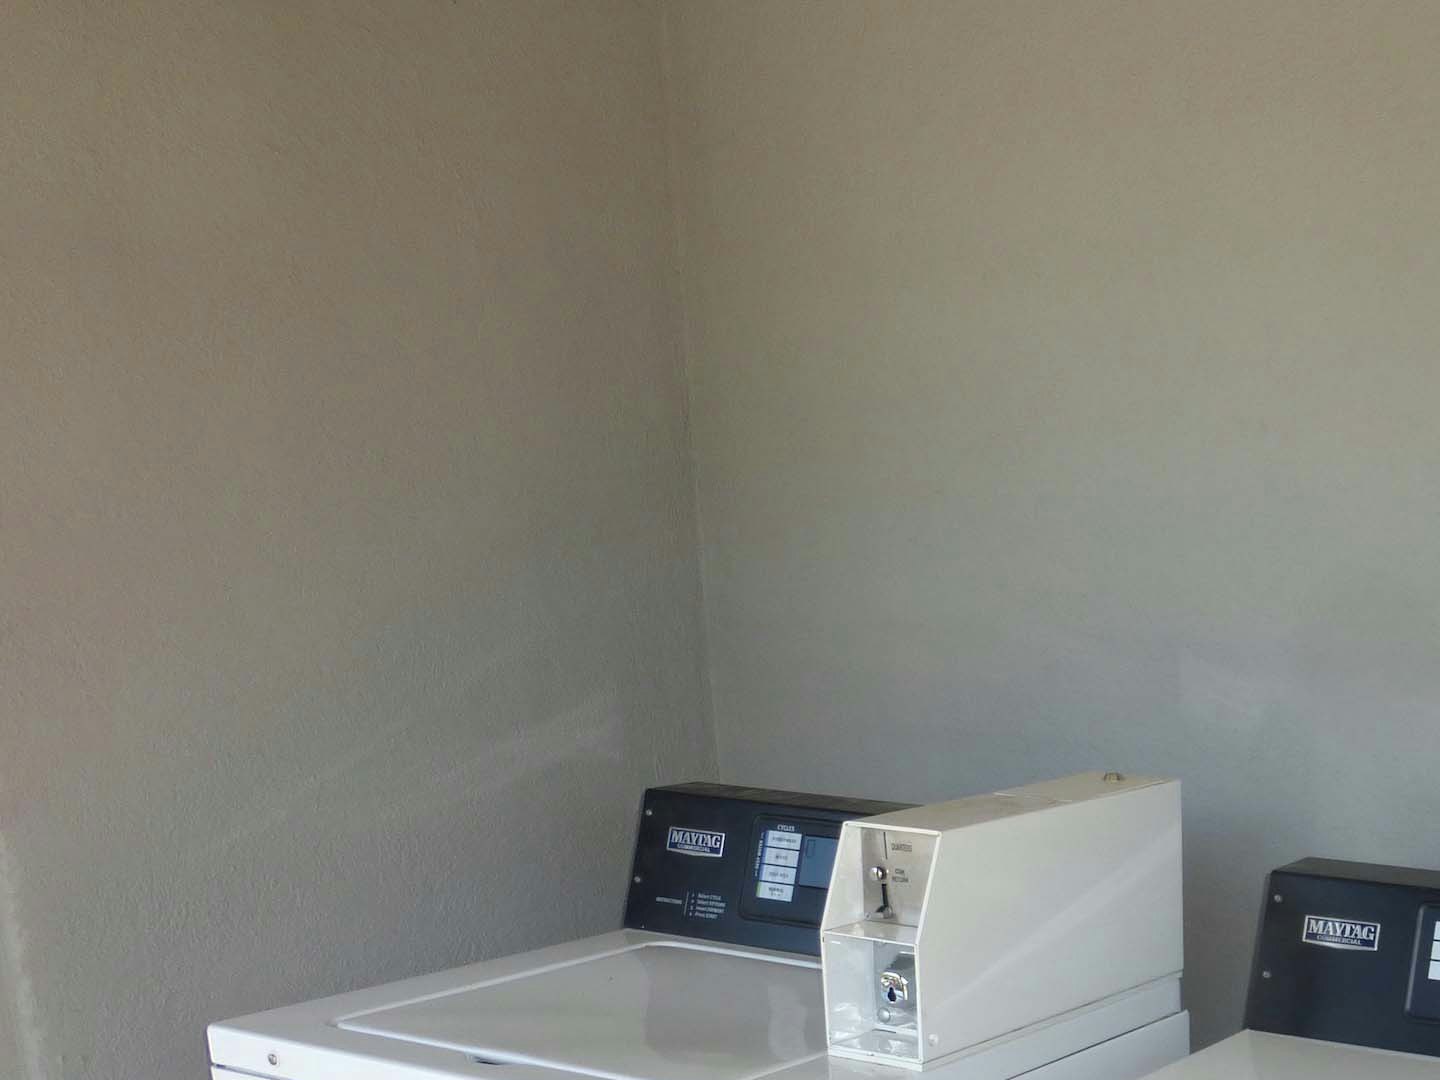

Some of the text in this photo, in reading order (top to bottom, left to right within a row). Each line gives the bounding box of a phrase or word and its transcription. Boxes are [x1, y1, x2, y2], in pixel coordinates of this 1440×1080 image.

[671, 831, 720, 848] MAYTAG
[1308, 919, 1375, 940] MAYTAG
[1317, 935, 1361, 945] COMMERCIAL
